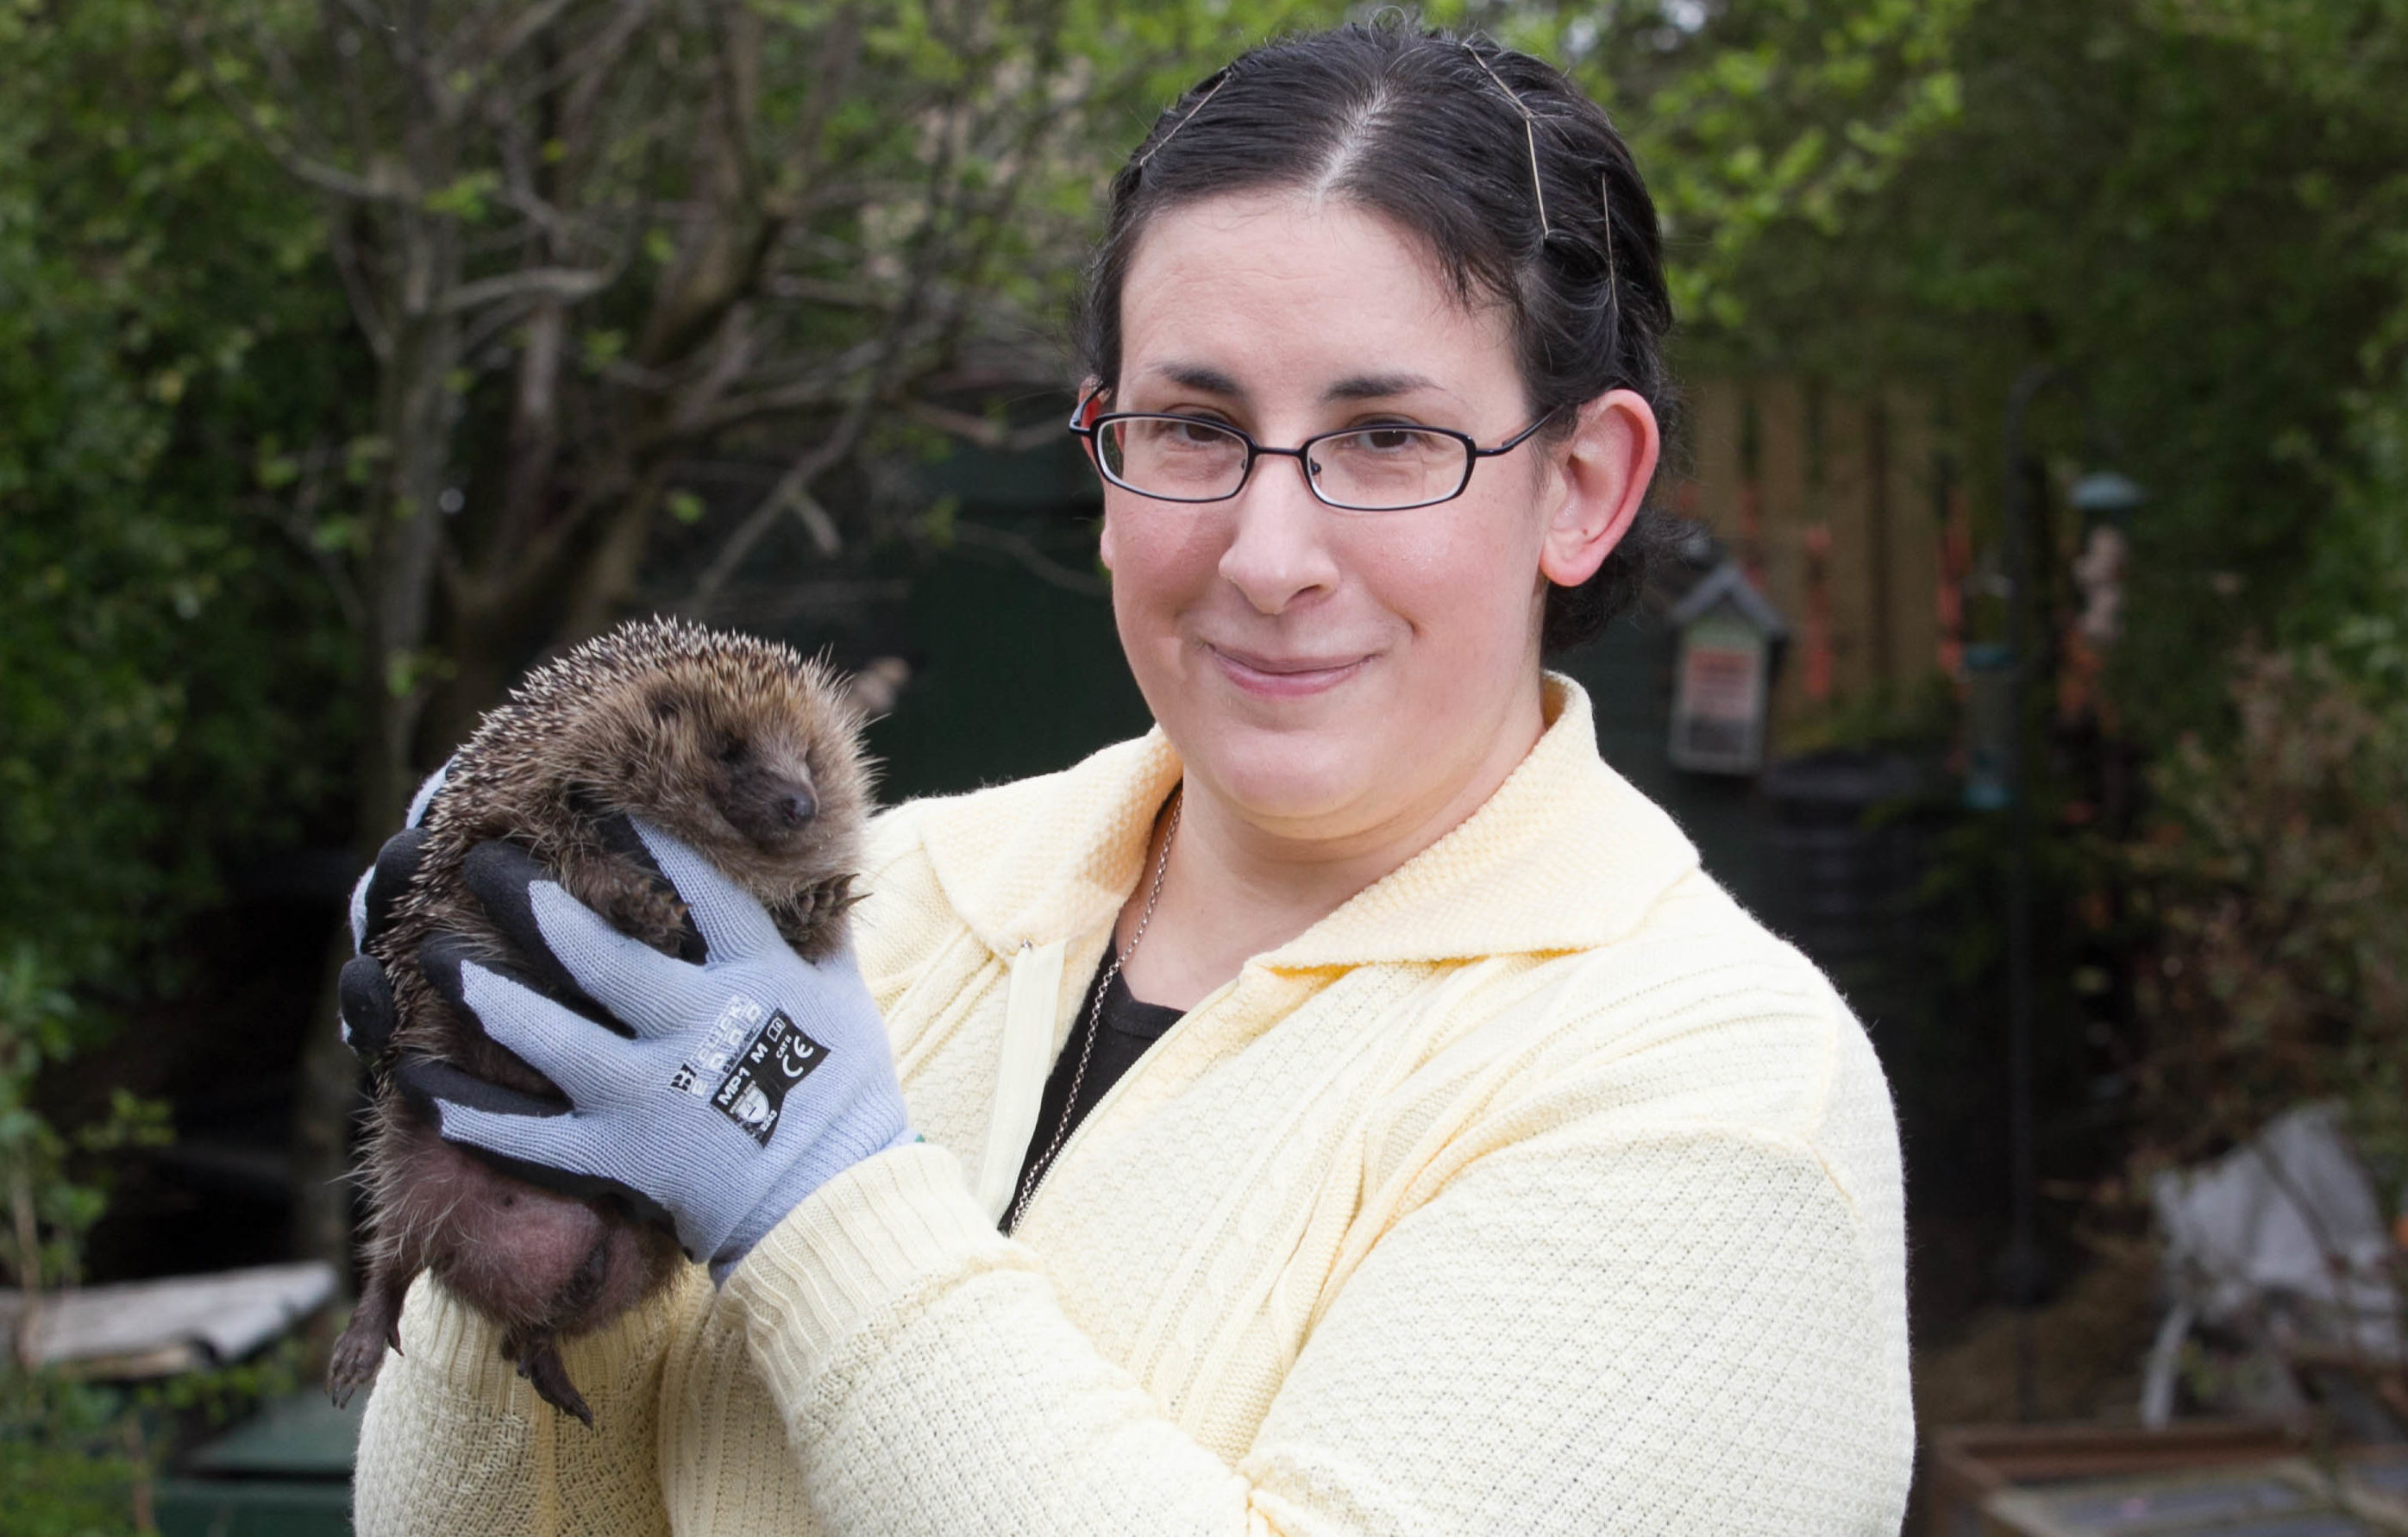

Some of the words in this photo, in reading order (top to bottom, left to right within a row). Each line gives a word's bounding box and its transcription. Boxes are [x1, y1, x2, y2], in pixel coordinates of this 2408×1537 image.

[775, 1041, 787, 1058] CAT
[781, 1035, 814, 1077] CE
[717, 1066, 750, 1106] MP1
[749, 1042, 769, 1064] M
